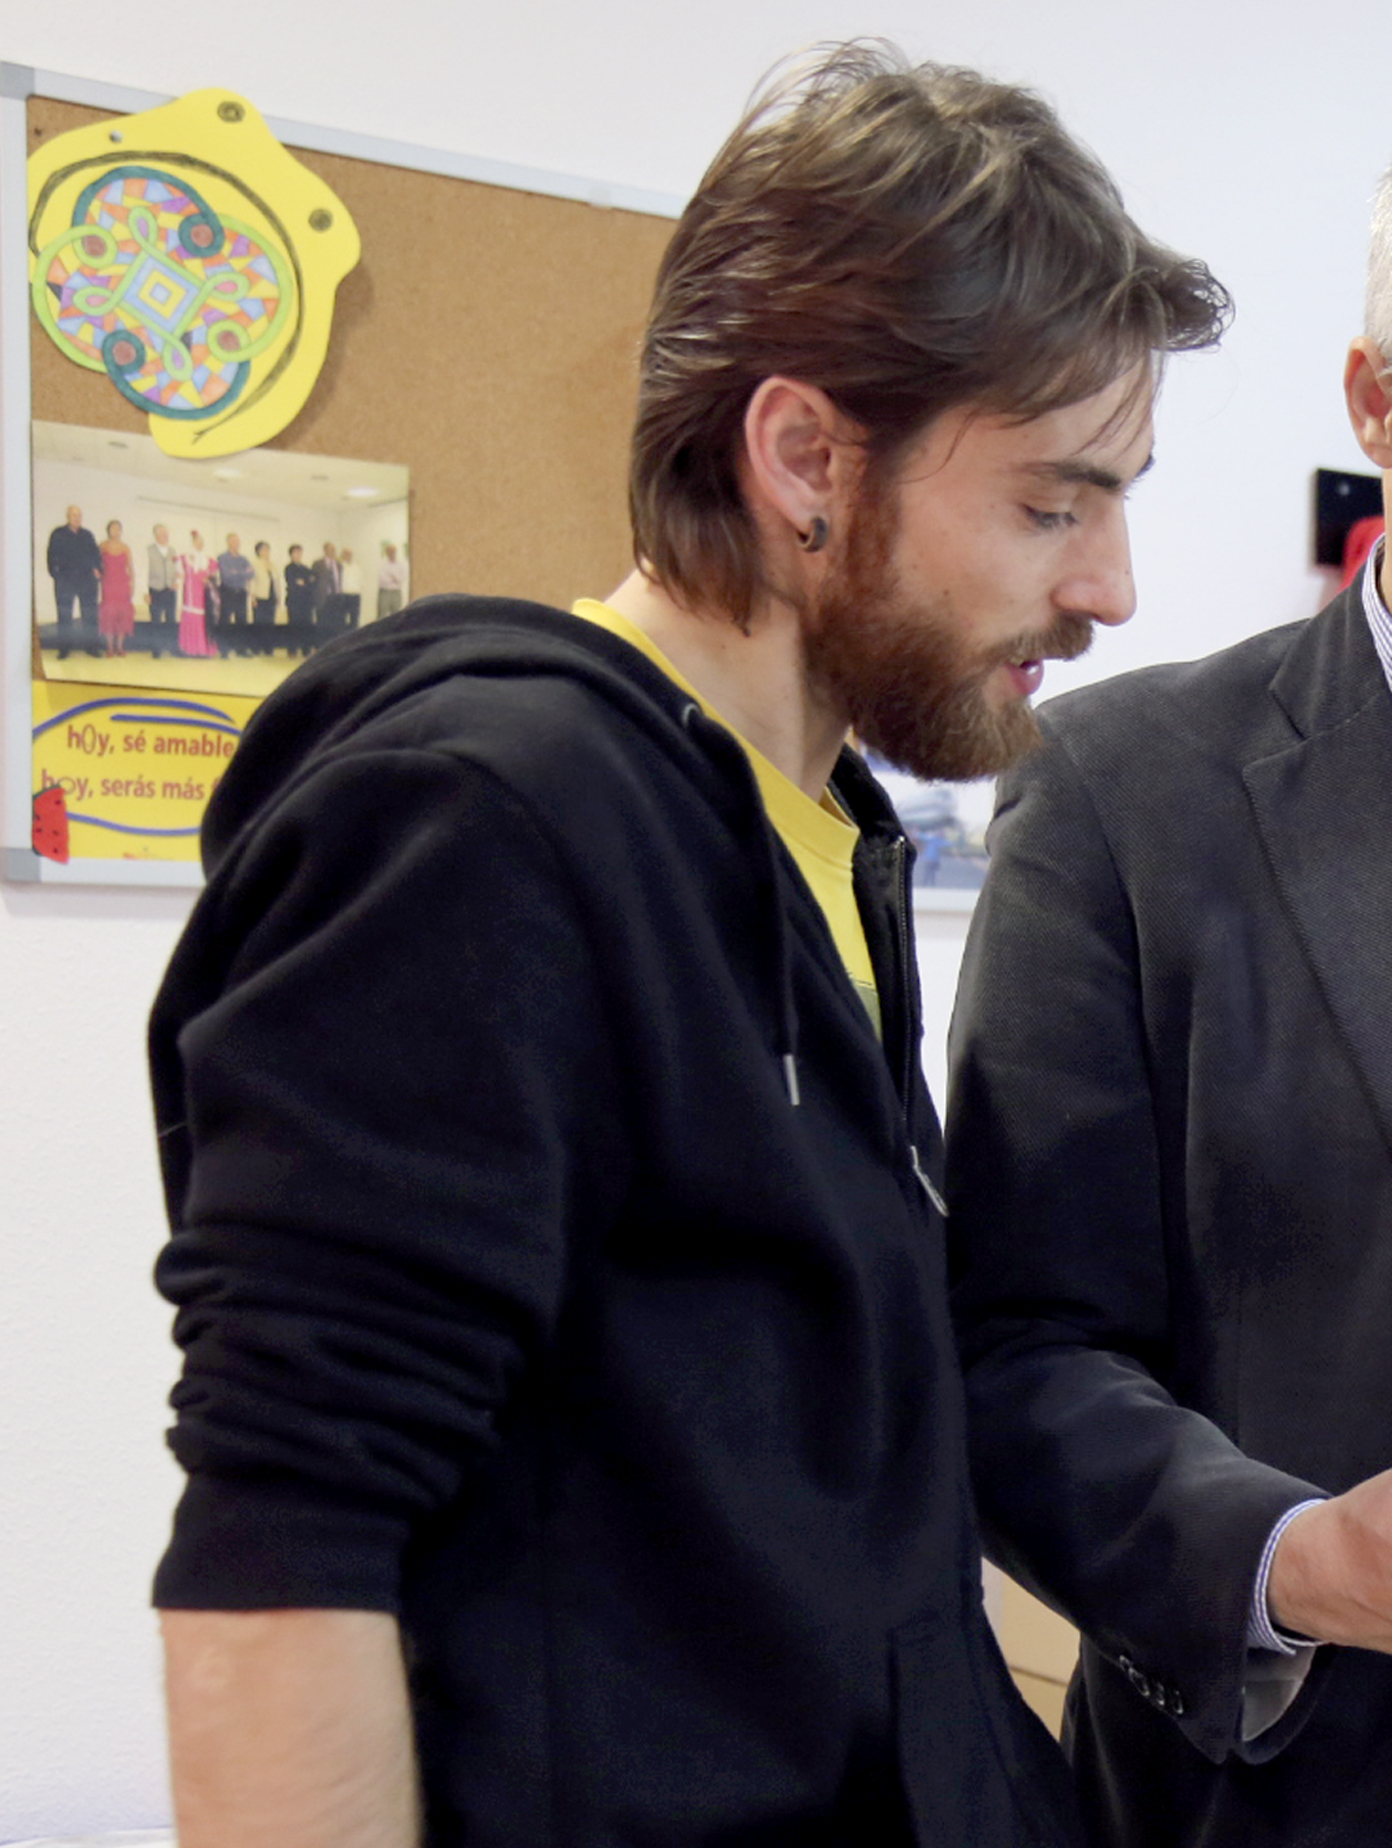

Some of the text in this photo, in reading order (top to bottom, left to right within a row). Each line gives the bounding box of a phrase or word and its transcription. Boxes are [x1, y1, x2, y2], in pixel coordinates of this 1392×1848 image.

[123, 730, 147, 753] sé
[101, 774, 155, 799] serás
[162, 776, 204, 800] más
